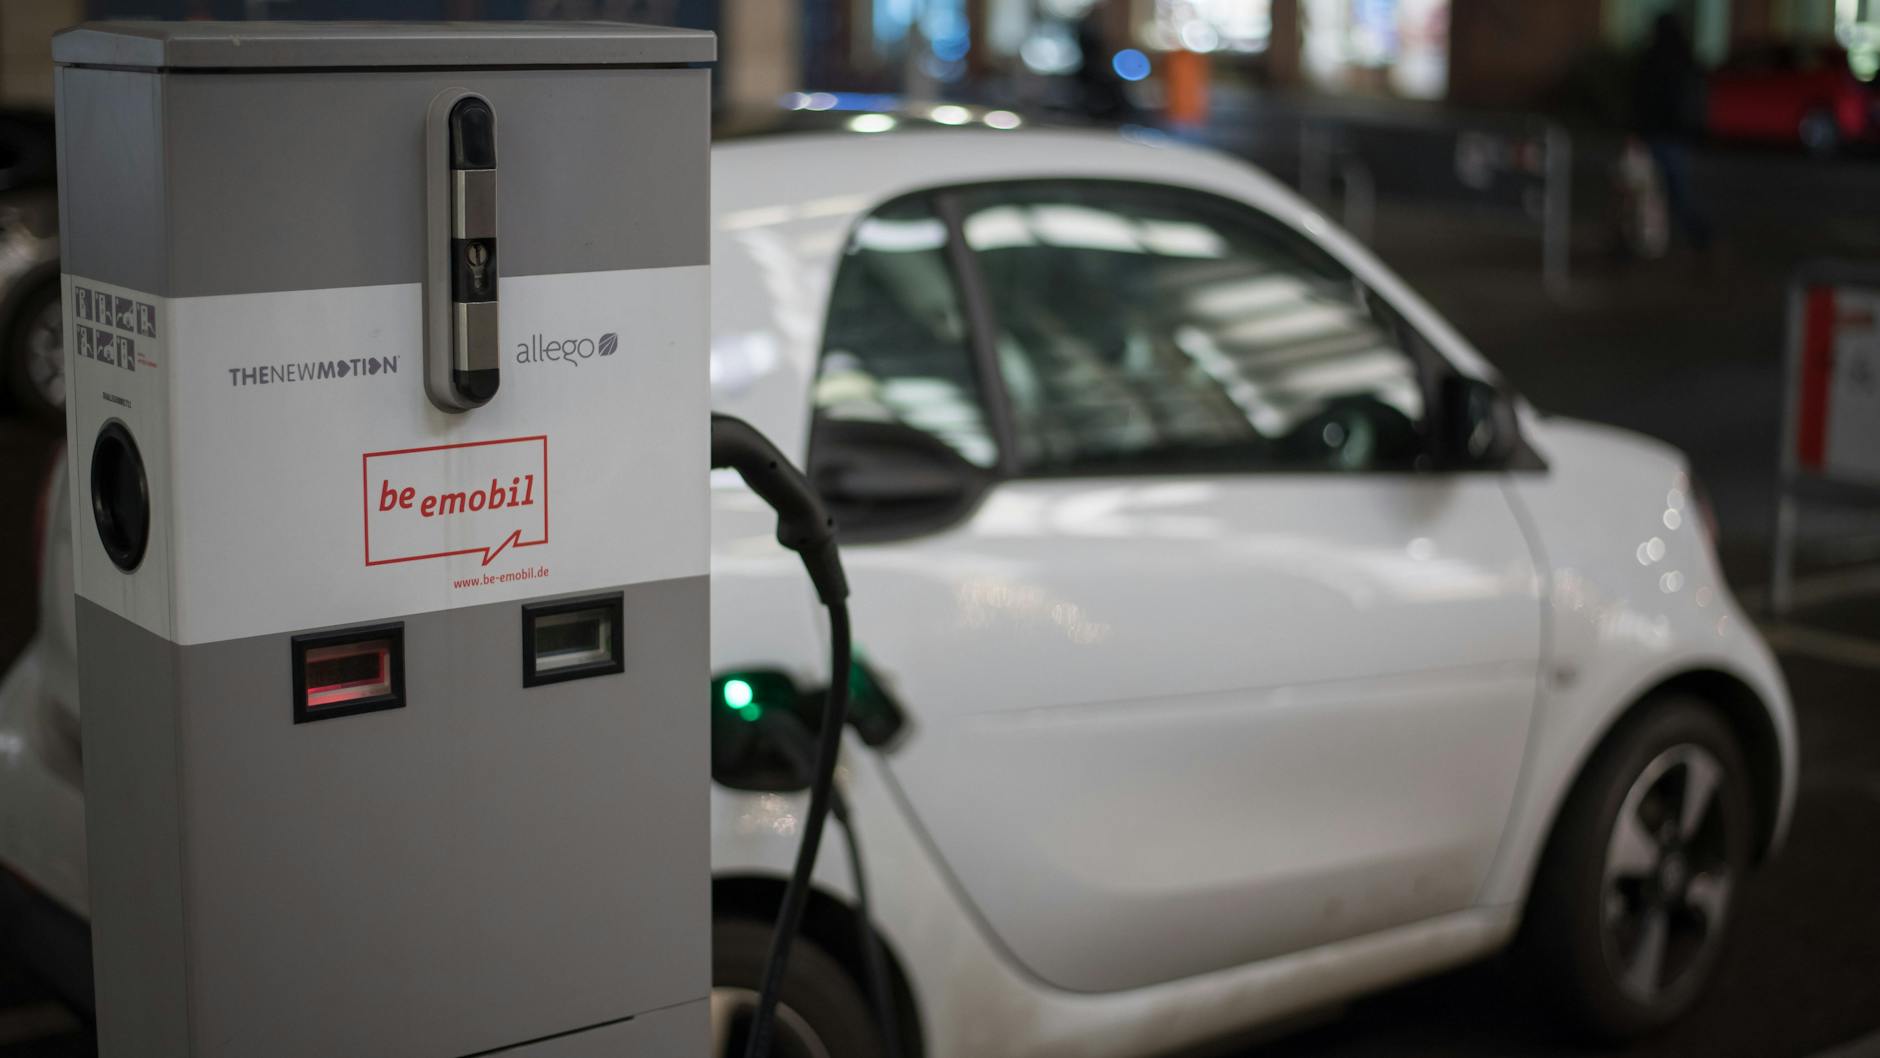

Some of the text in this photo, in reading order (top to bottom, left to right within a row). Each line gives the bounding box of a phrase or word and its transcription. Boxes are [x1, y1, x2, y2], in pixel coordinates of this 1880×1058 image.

[516, 333, 595, 367] allego
[379, 474, 534, 518] be emobil
[453, 566, 550, 589] www.be-emobil.de
